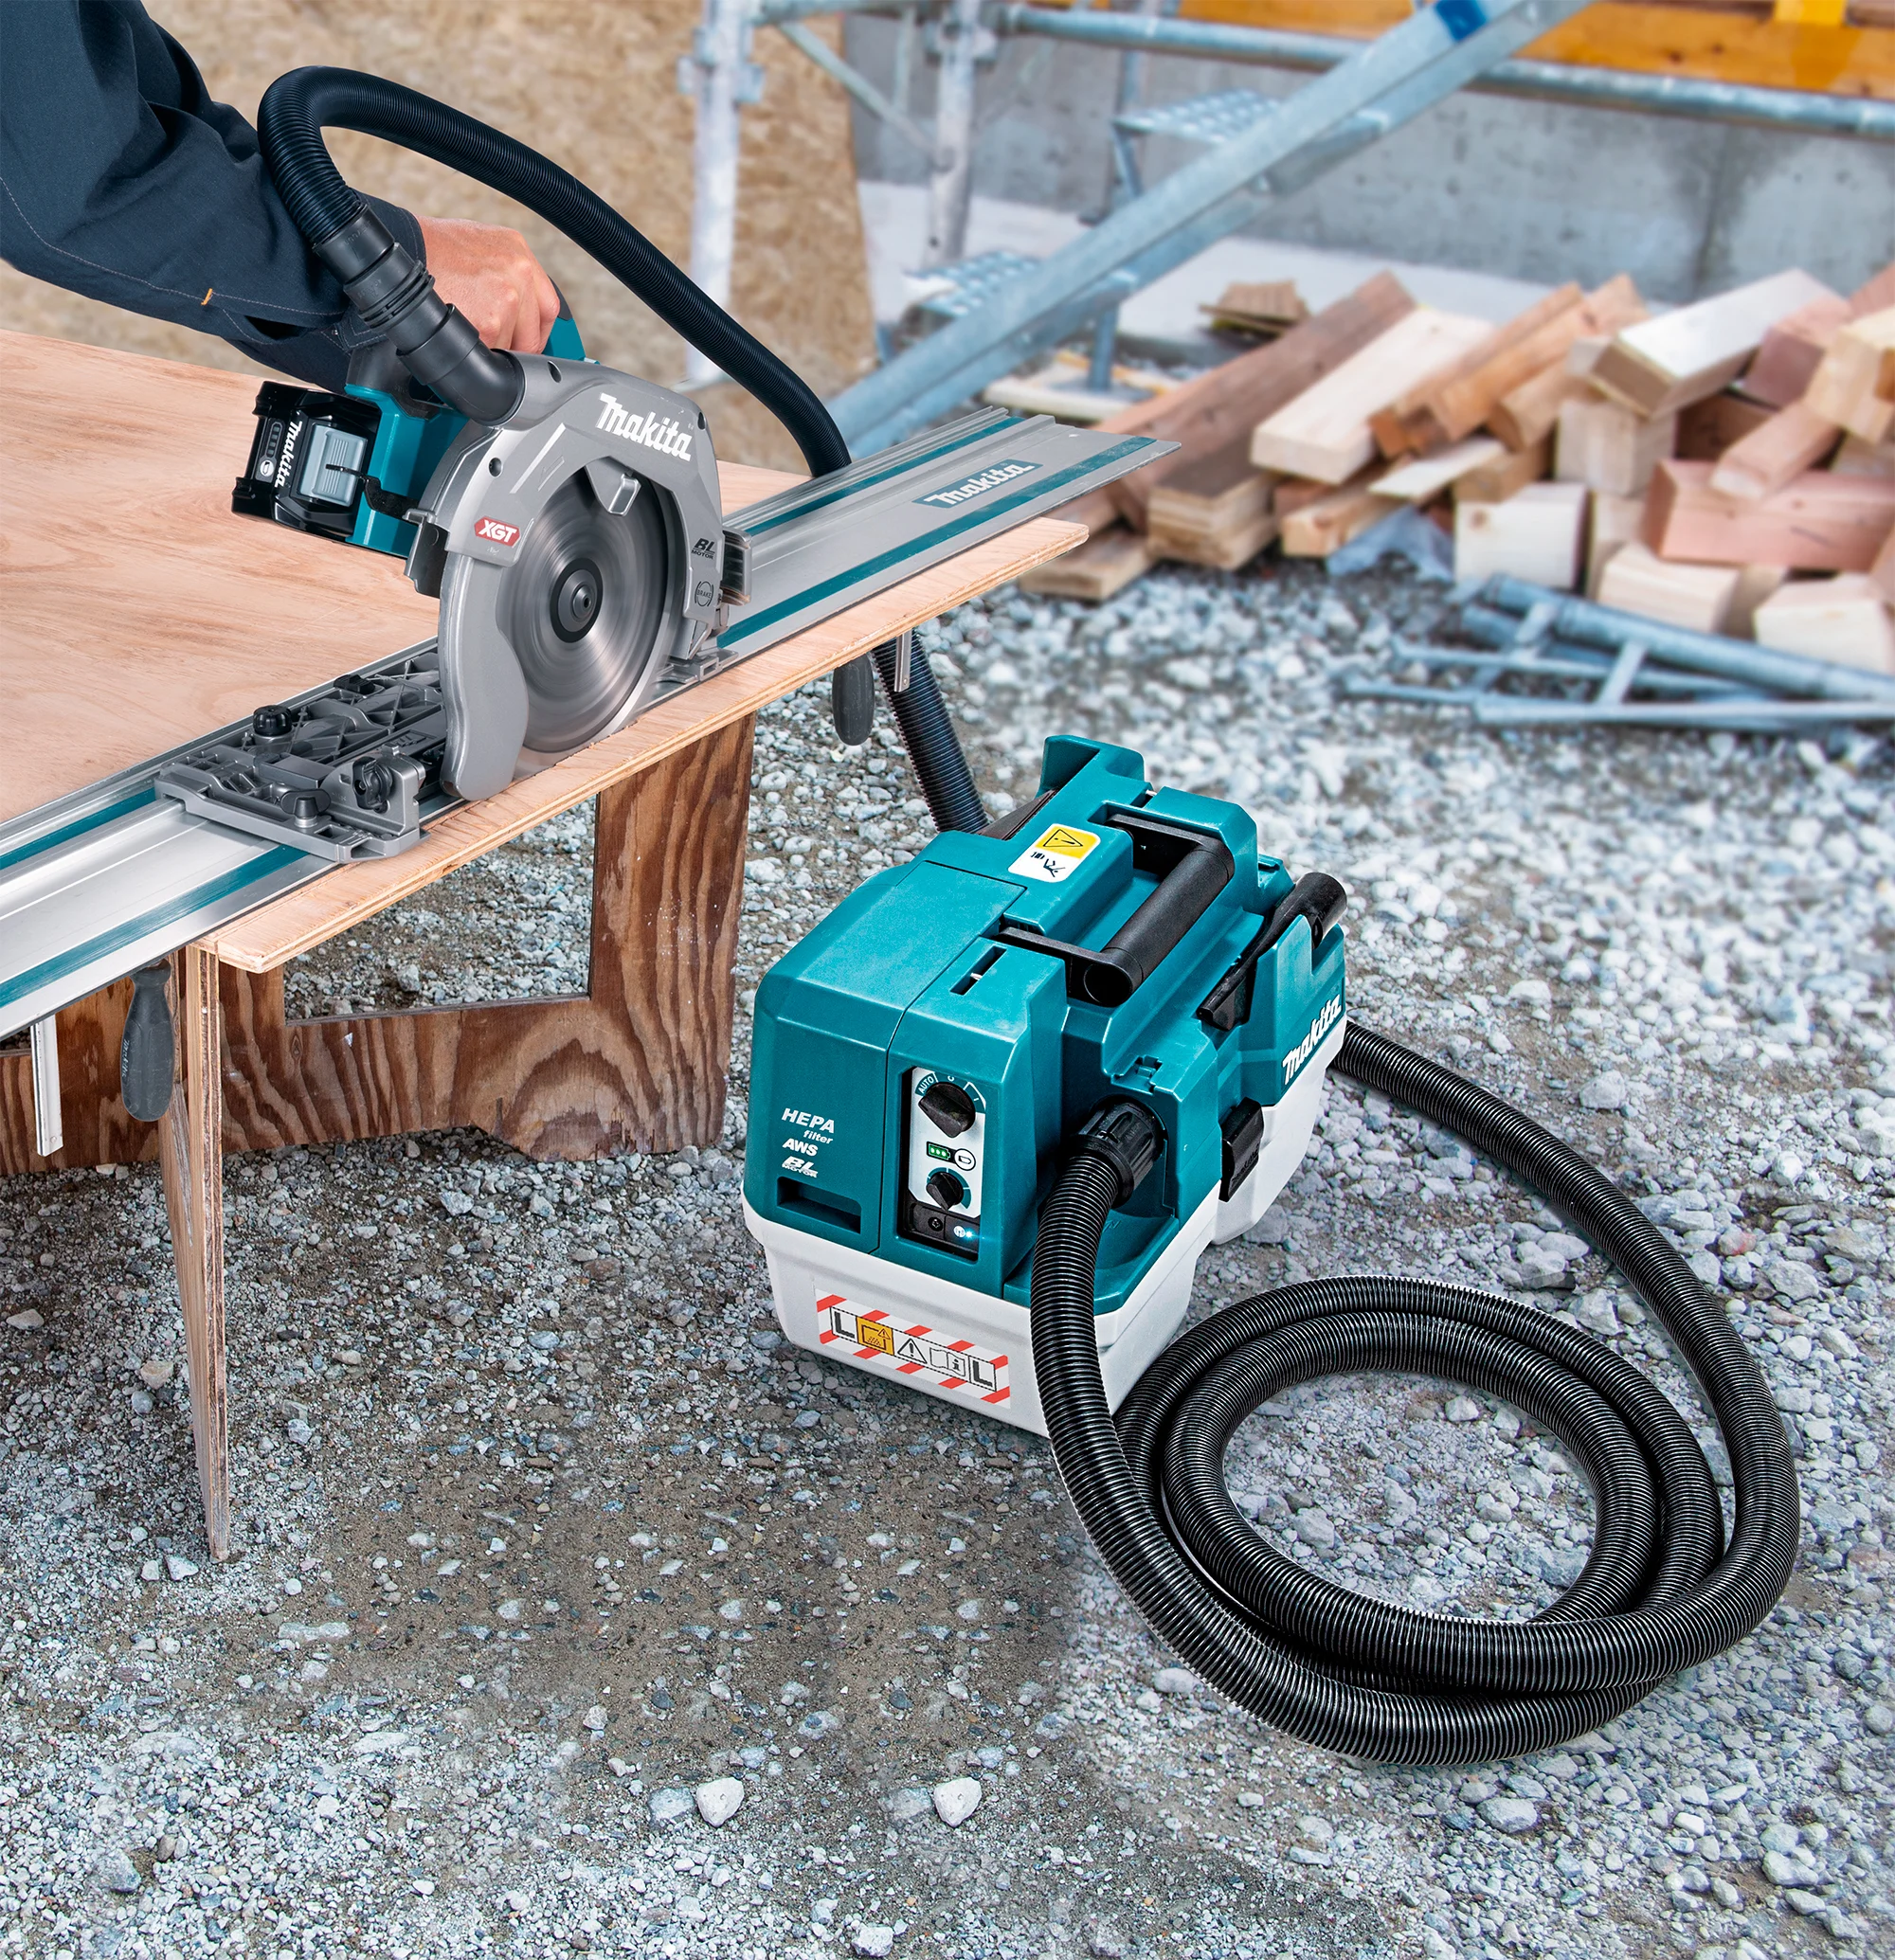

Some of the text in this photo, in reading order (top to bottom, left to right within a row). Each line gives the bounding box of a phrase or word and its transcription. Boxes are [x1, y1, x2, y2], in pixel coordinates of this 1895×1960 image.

[478, 519, 517, 543] XGT
[691, 549, 714, 560] MOTOR
[693, 537, 716, 554] BL
[696, 588, 712, 599] BRAKE
[917, 1075, 934, 1094] AUTO
[781, 1107, 835, 1134] HEPA
[803, 1129, 834, 1144] filter
[782, 1138, 819, 1157] AWS
[782, 1156, 819, 1175] BL
[834, 1311, 856, 1340] L
[972, 1359, 994, 1388] L
